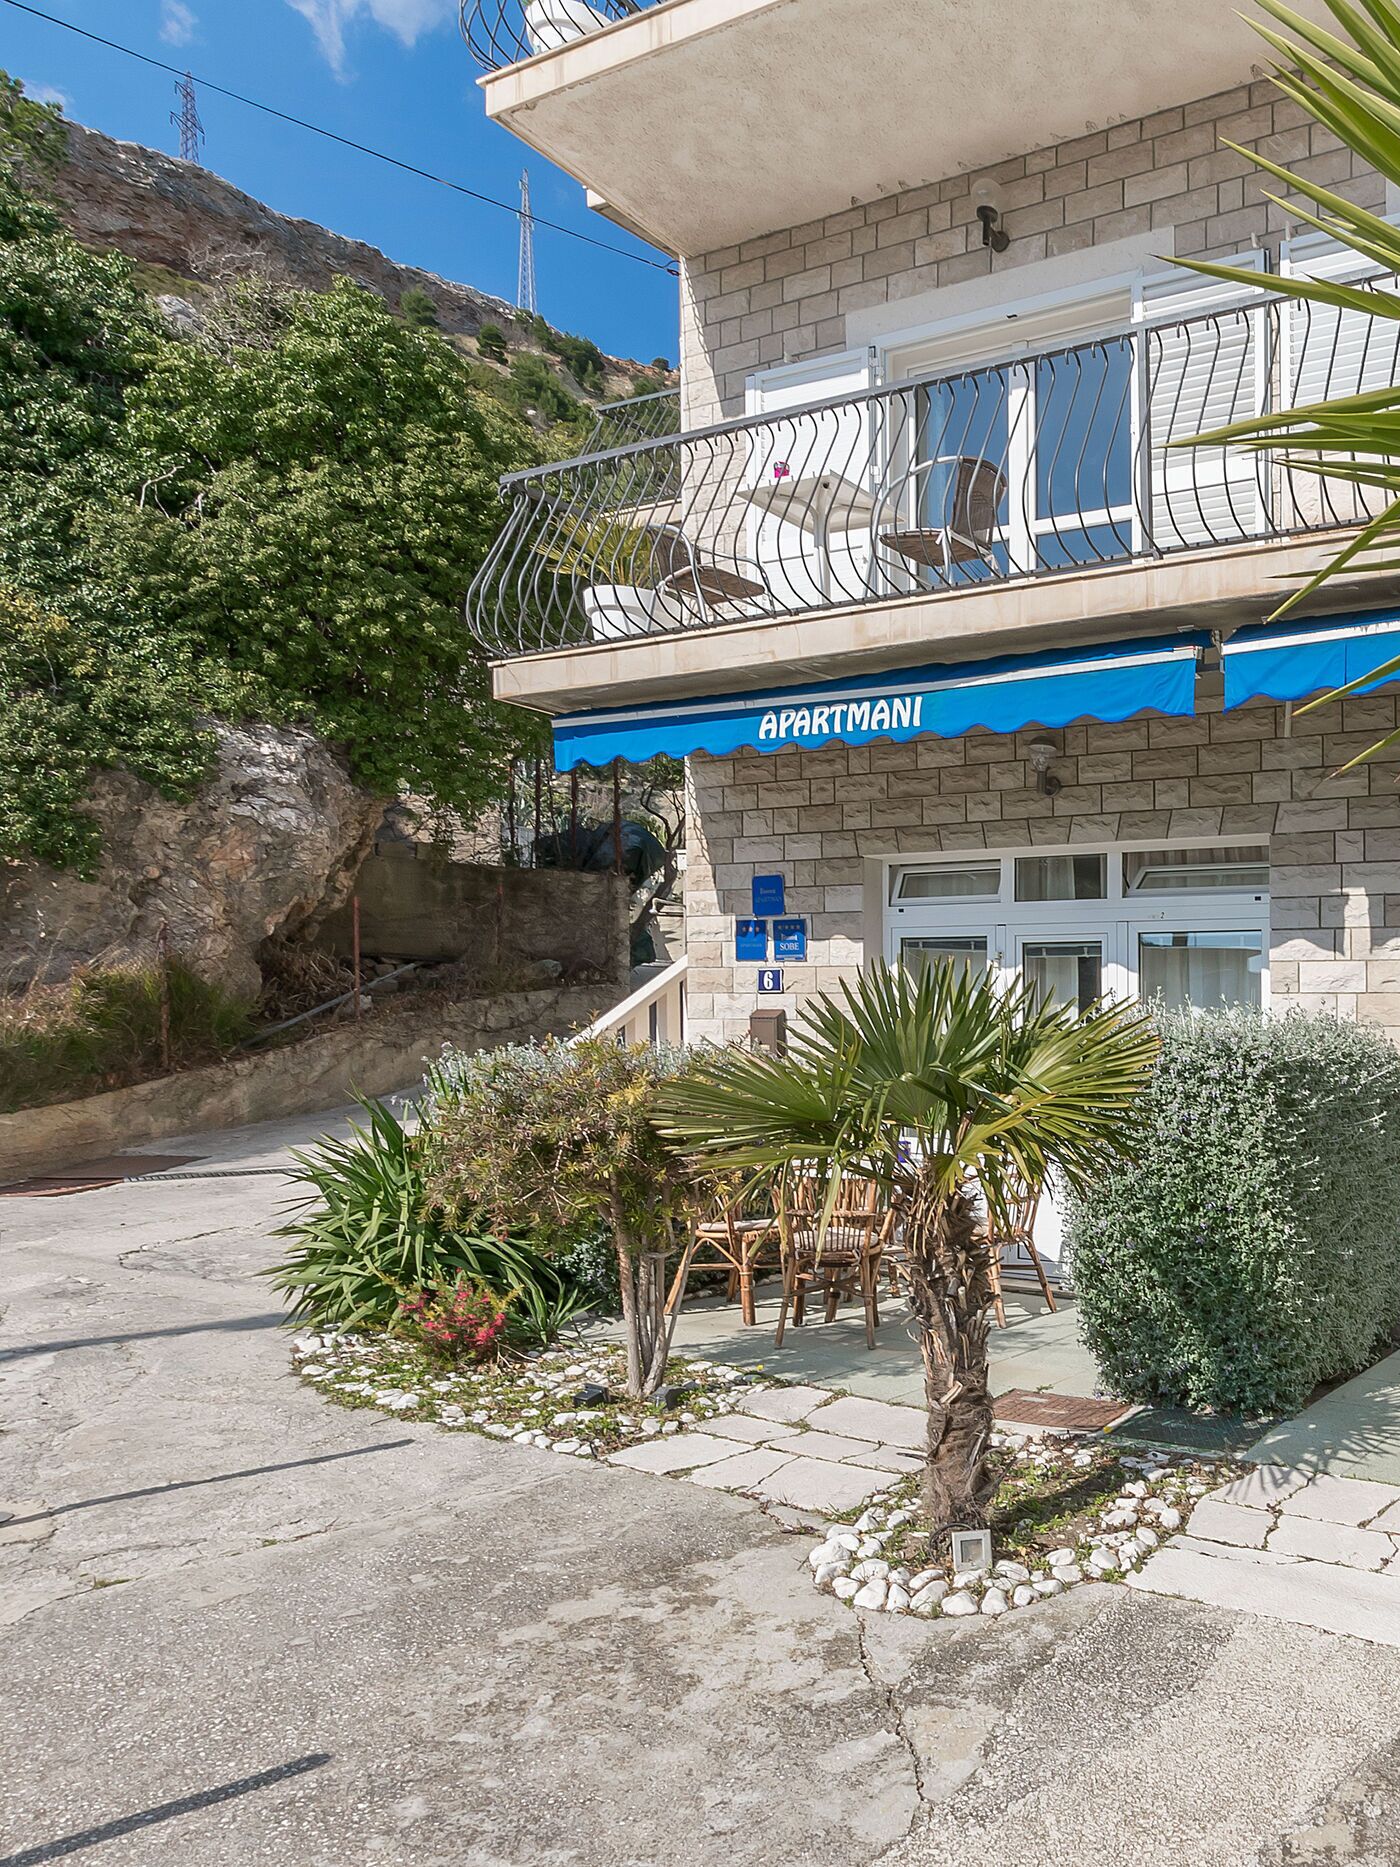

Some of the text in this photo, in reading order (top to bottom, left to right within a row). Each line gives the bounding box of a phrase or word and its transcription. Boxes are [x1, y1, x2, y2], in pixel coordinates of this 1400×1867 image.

[759, 696, 923, 740] APARTMANI
[779, 942, 800, 951] SOBE
[763, 971, 774, 990] 6
